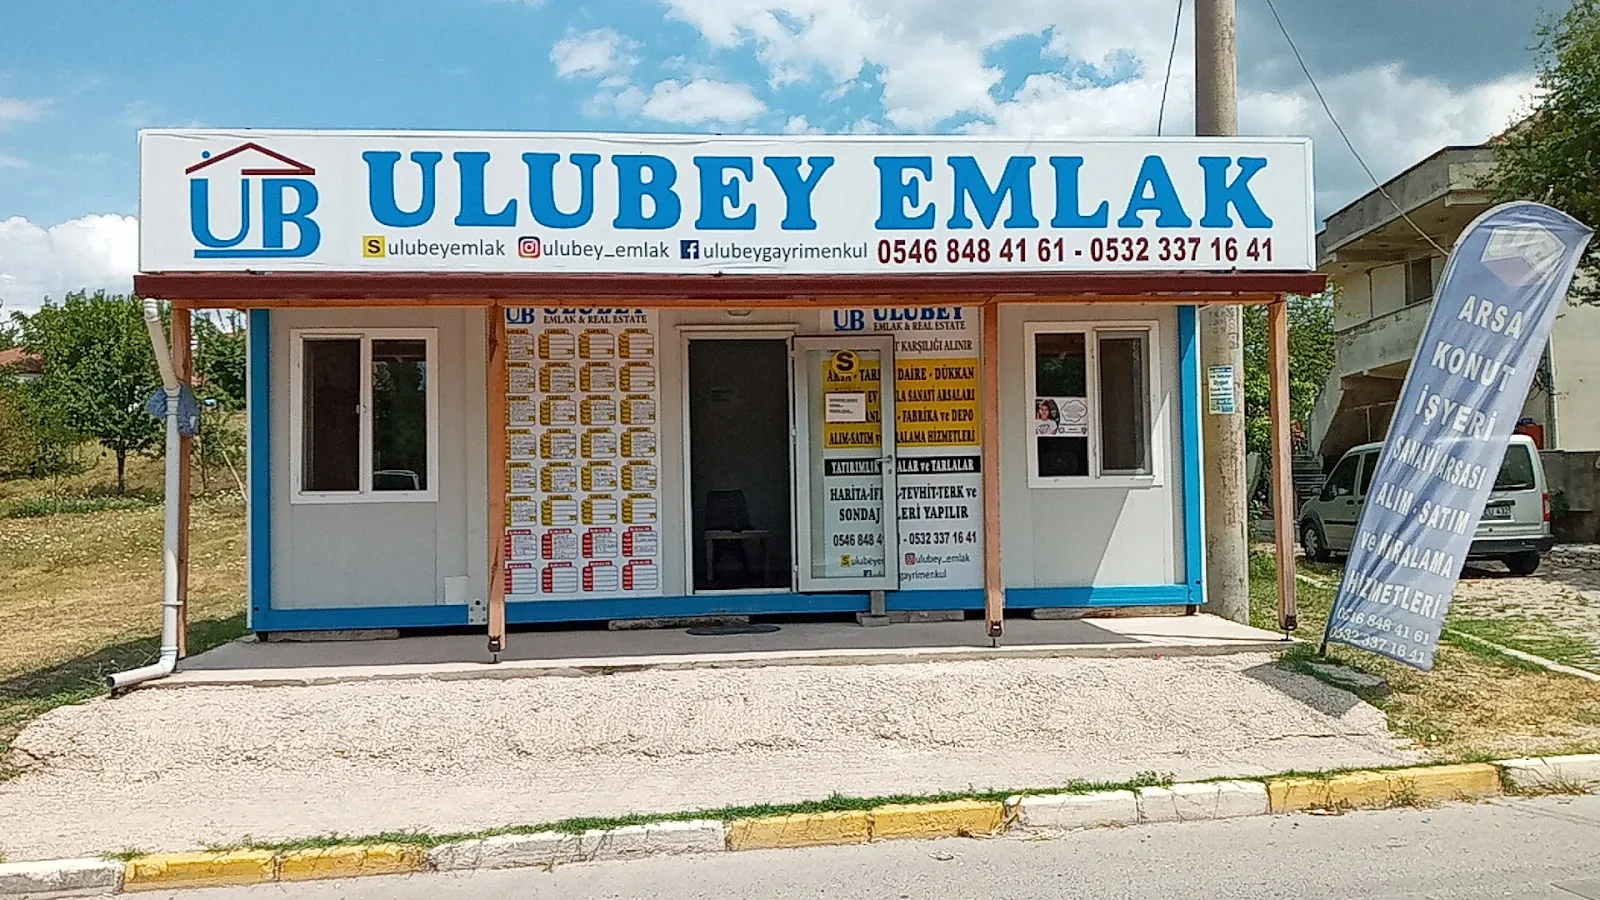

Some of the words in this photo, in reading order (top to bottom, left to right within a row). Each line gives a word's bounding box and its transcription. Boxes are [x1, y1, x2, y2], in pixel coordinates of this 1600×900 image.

[362, 151, 834, 230] ULUBEY
[874, 155, 1273, 230] EMLAK
[388, 239, 506, 259] ulubeyemlak
[543, 240, 670, 260] ulubey_emlak
[703, 242, 868, 262] ulubeygayrimenkul
[878, 239, 937, 263] 0546
[946, 239, 991, 263] 848
[1000, 238, 1026, 262] 41
[1038, 238, 1064, 262] 61
[1090, 237, 1149, 261] 0532
[1158, 237, 1200, 261] 337
[1211, 237, 1237, 261] 16
[1246, 237, 1272, 261] 41
[543, 315, 577, 324] EMLAK
[588, 315, 610, 324] REAL
[613, 315, 647, 324] ESTATE
[873, 322, 903, 332] EMLAK
[912, 322, 933, 331] REAL
[935, 321, 965, 331] ESTATE
[1457, 294, 1523, 340] ARSA
[897, 364, 927, 381] DAİRE
[934, 363, 975, 380] DÜKKAN
[1431, 341, 1516, 392] KONUT
[902, 406, 939, 423] FABRİKA
[951, 408, 974, 422] DEPO
[1415, 384, 1498, 442] İŞYERİ
[931, 459, 974, 472] TARLALAR
[1435, 453, 1487, 491] ARSASI
[965, 487, 977, 498] ve
[839, 507, 881, 524] SONDAJ
[923, 505, 969, 519] YAPILIR
[1375, 481, 1415, 516] ALIM
[1418, 499, 1472, 536] SATIM
[833, 534, 855, 547] 0546
[909, 532, 931, 545] 0532
[933, 531, 950, 544] 337
[953, 531, 963, 543] 16
[965, 530, 977, 543] 41
[1360, 531, 1378, 552] ve
[1377, 532, 1454, 579] KİRALAMA
[1346, 569, 1443, 620] HİZMETLERİ
[1366, 614, 1393, 632] 848
[1394, 623, 1411, 639] 41
[1413, 630, 1431, 646] 61
[1389, 642, 1407, 658] 16
[1408, 648, 1426, 665] 41
